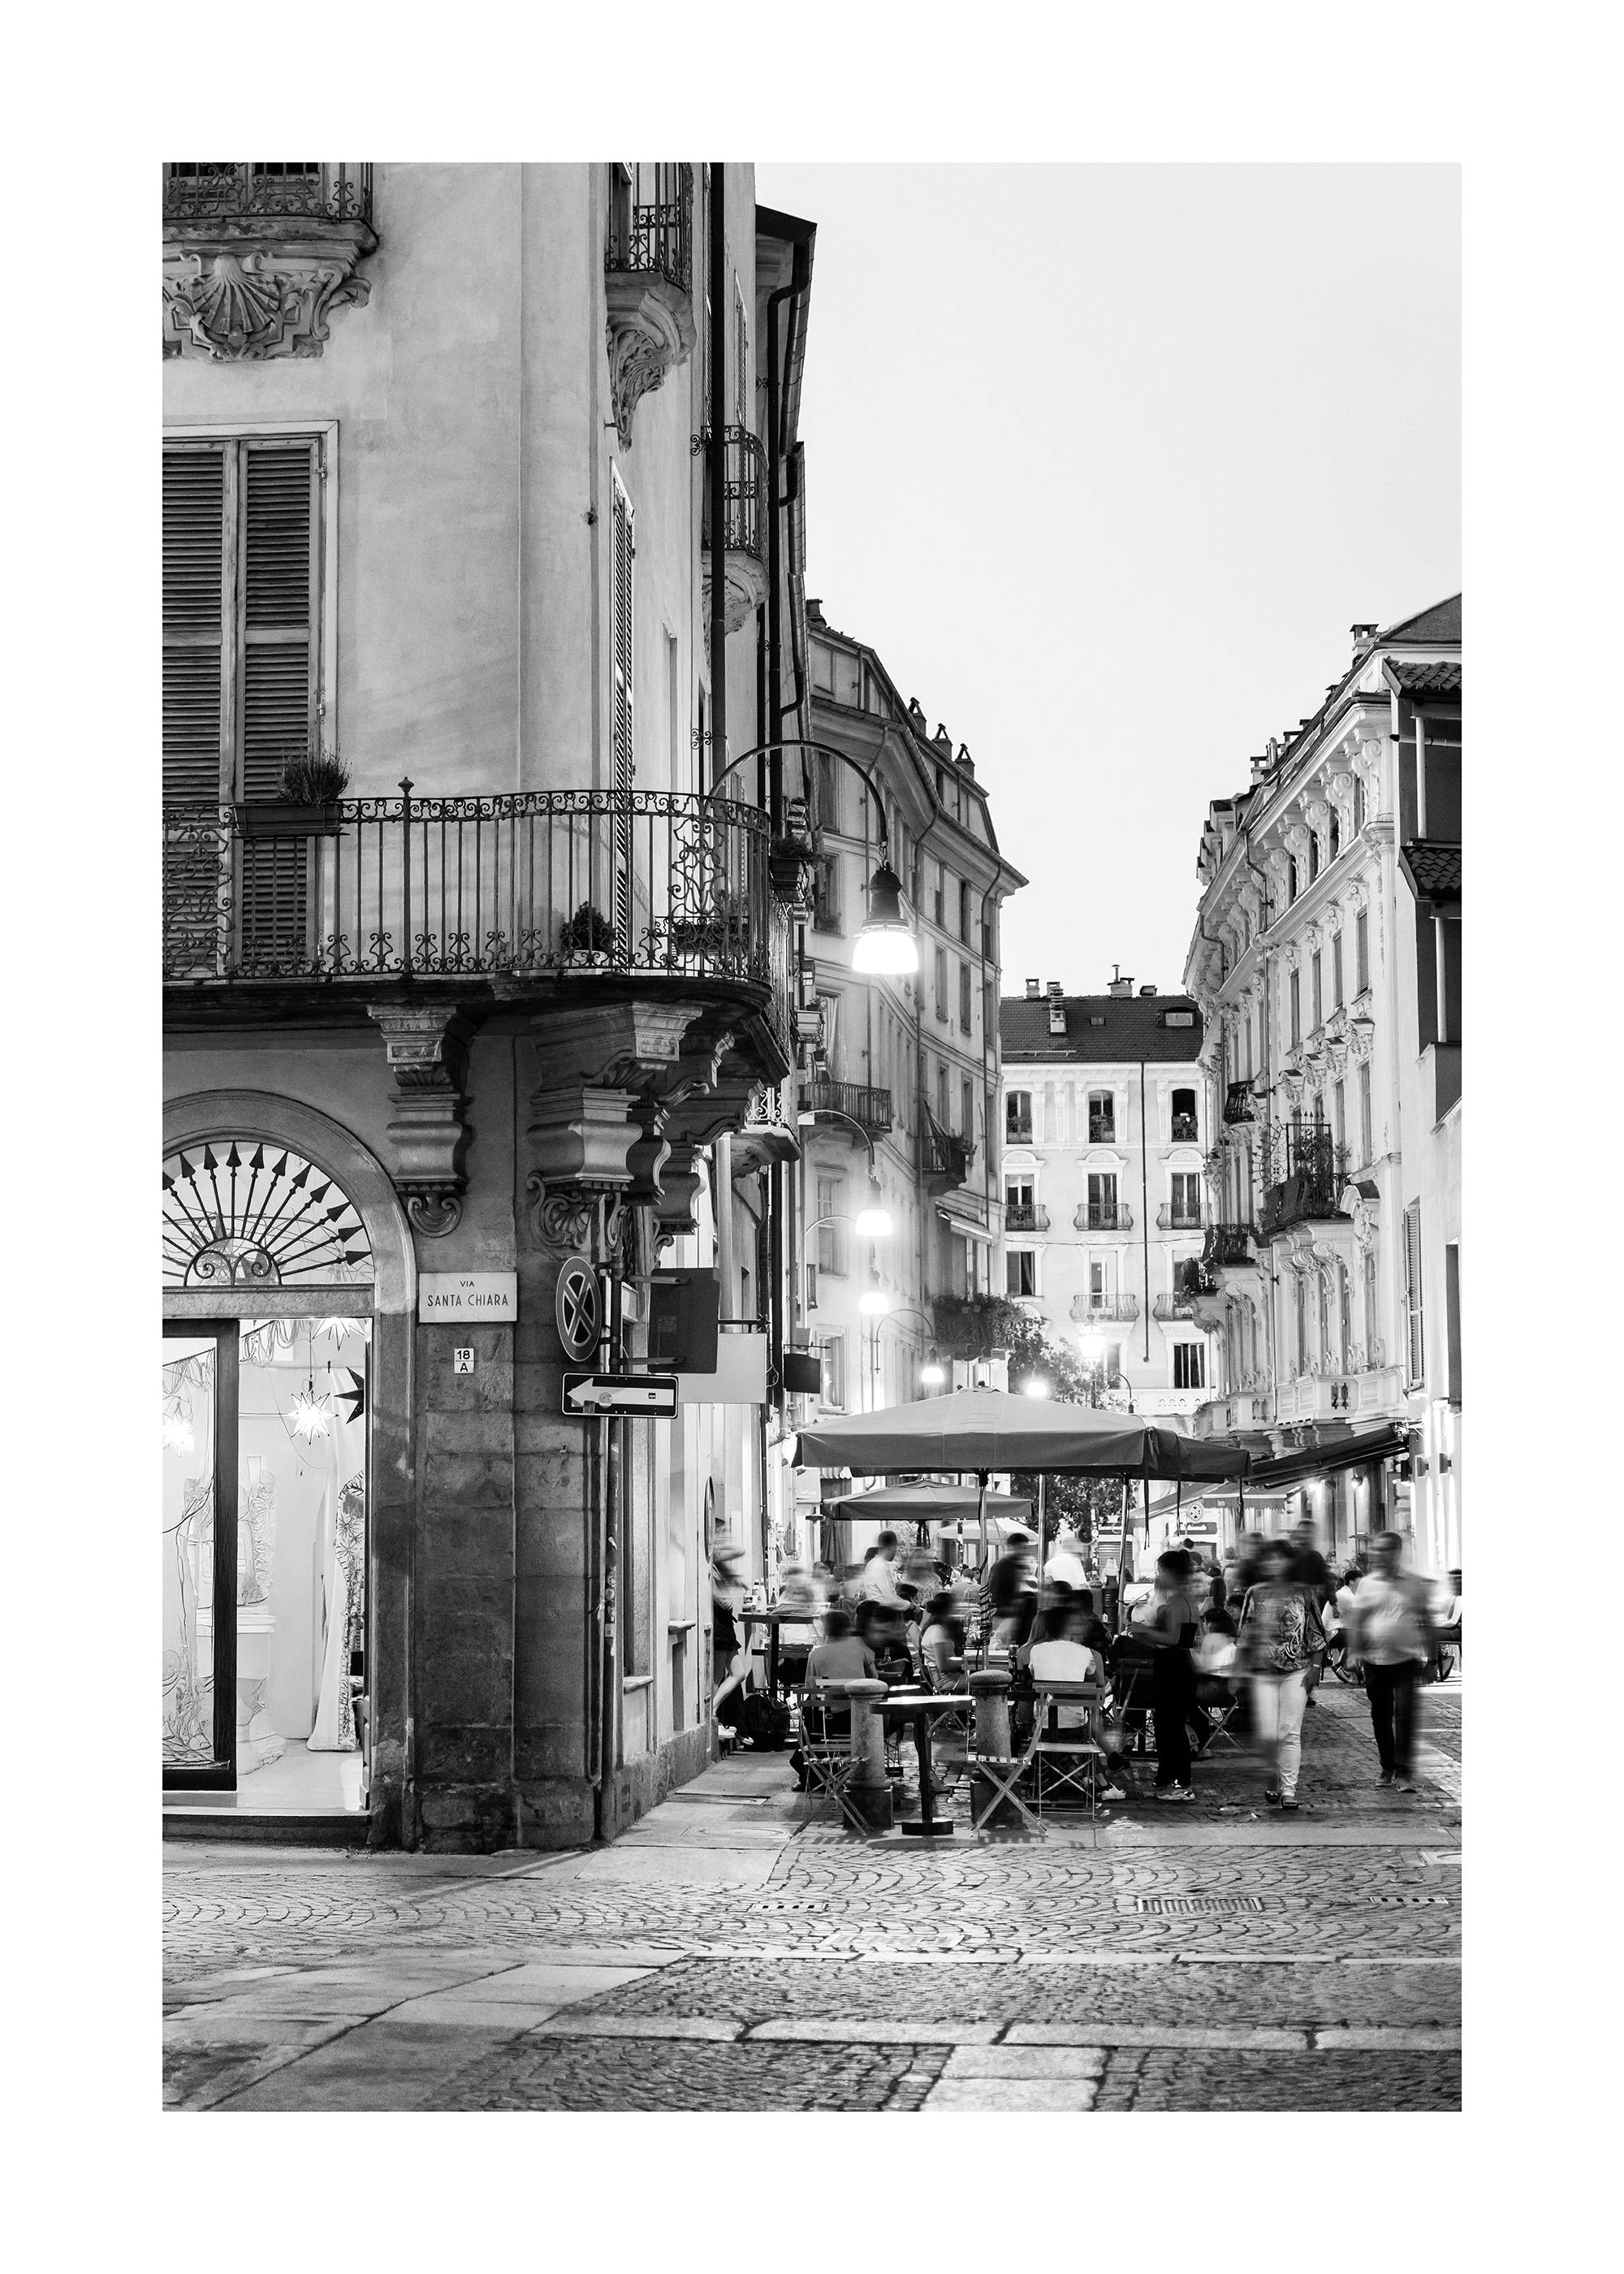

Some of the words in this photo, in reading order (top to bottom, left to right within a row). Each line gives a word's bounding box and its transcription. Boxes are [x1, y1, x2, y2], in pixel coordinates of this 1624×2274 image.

[427, 1295, 462, 1307] SANTA
[468, 1294, 508, 1307] CHIARA
[456, 1350, 470, 1360] 18
[460, 1362, 469, 1373] A
